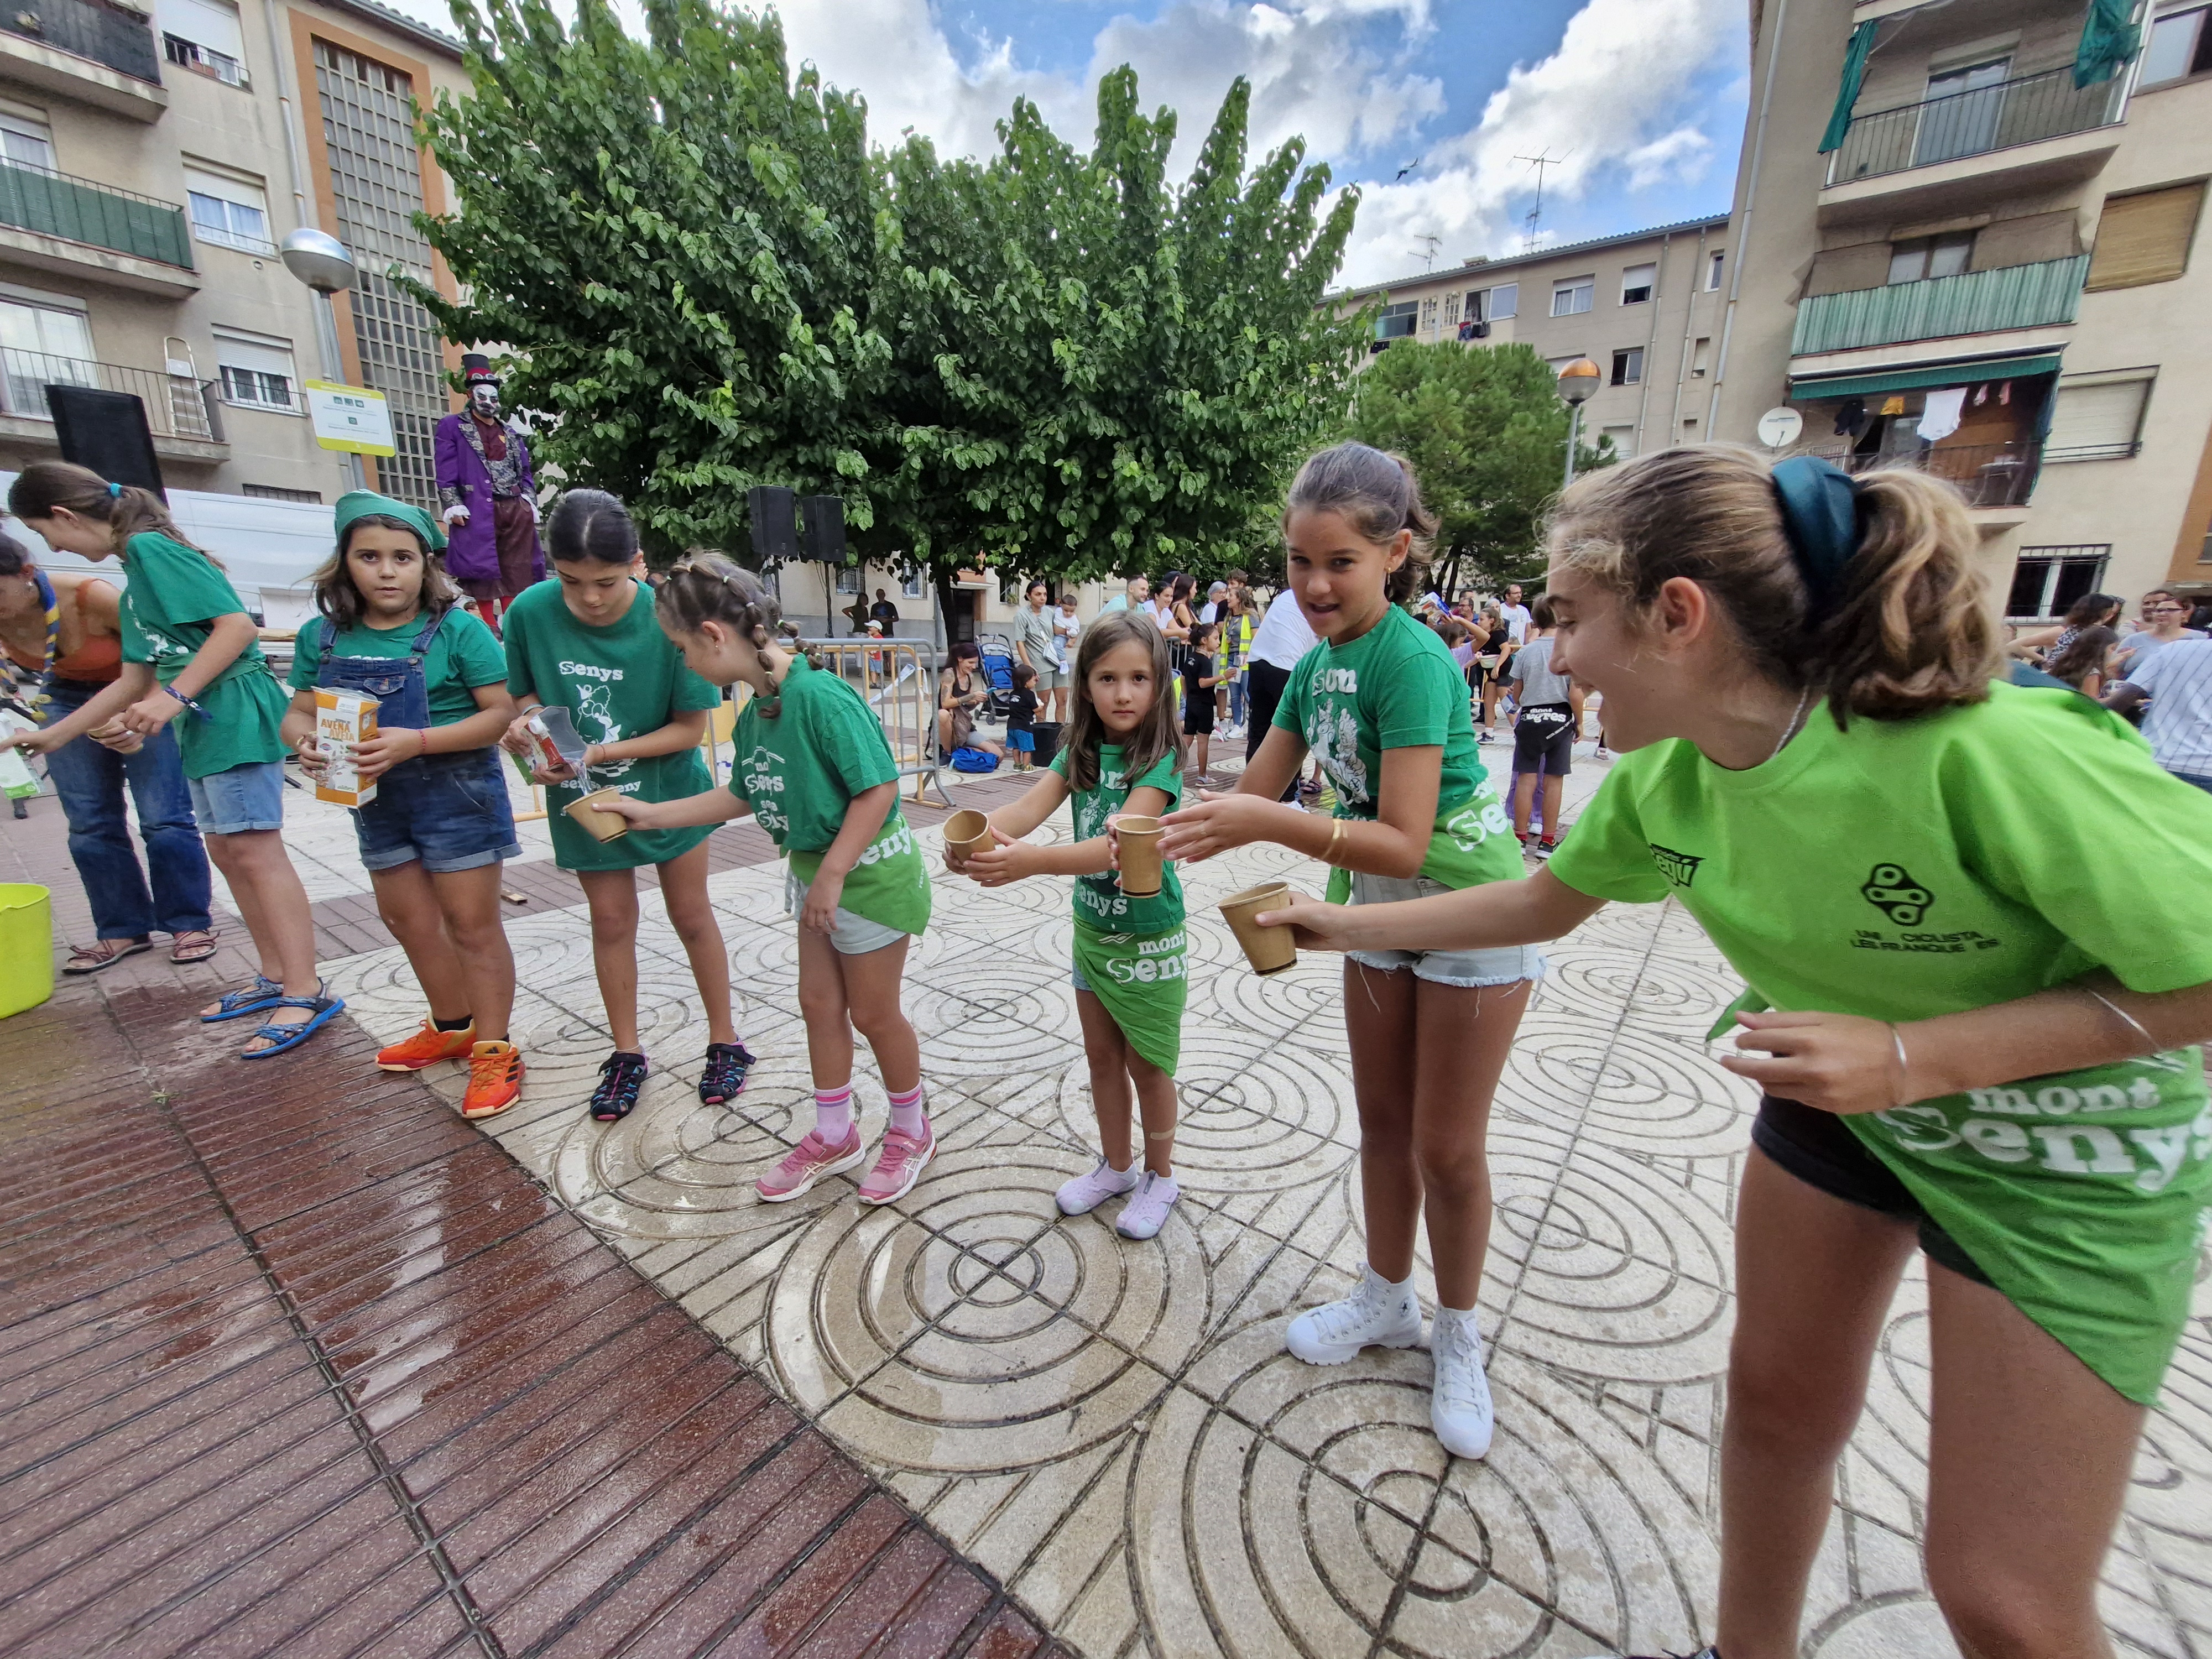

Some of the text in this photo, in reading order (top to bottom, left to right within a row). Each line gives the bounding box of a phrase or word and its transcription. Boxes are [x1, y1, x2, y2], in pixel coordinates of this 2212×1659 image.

[559, 661, 623, 682] Senys
[321, 718, 350, 733] AVENA
[605, 780, 641, 793] eny
[849, 826, 911, 872] eny
[1137, 930, 1185, 954] mont
[1964, 1077, 2161, 1115] mont
